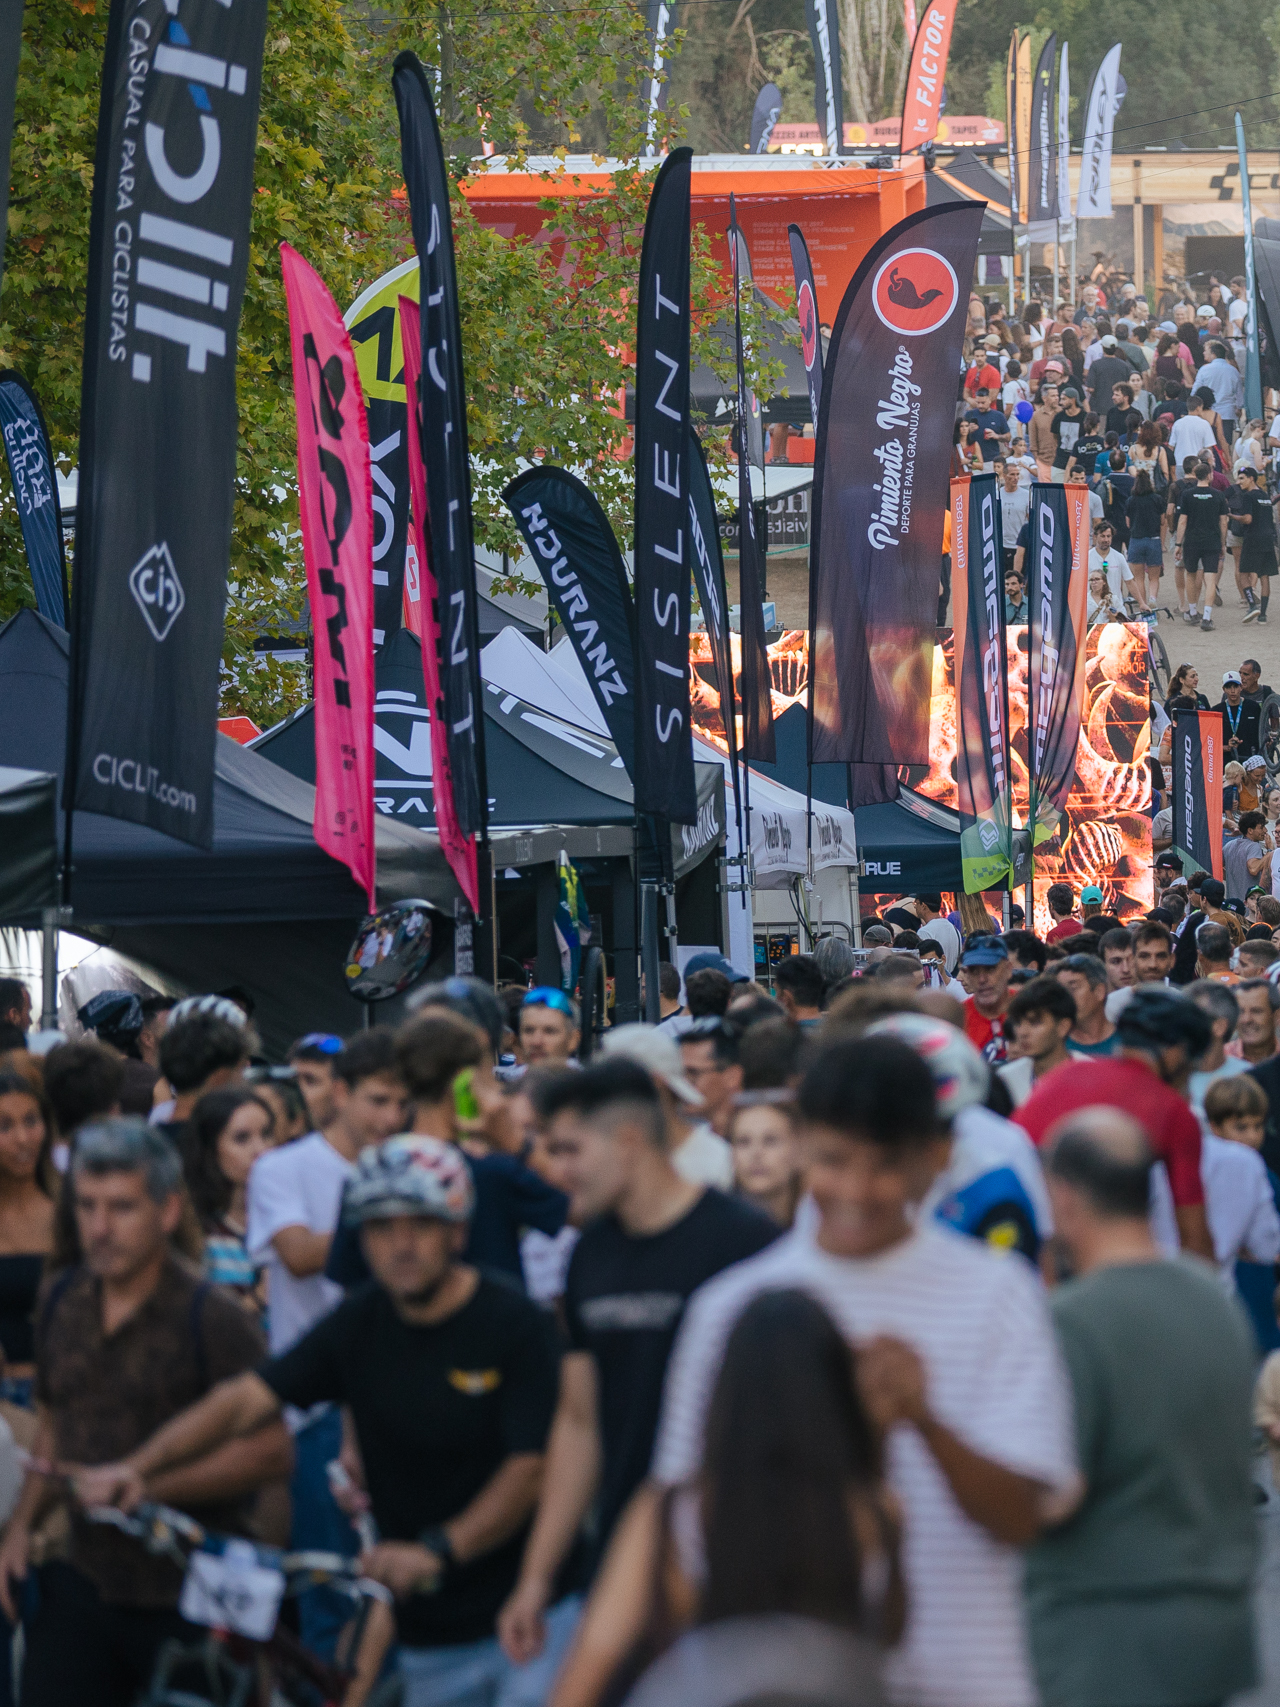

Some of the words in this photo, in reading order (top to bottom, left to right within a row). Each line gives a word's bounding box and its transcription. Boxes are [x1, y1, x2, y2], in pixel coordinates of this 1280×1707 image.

[124, 17, 152, 141] CASUAL
[915, 9, 946, 108] FACTOR
[117, 139, 138, 213] PARA
[109, 222, 133, 363] CICLISTAS
[906, 402, 921, 458] GRANUJAS
[654, 273, 684, 743] SISLENT
[867, 437, 904, 550] Pimiento
[904, 460, 916, 487] PARA
[900, 488, 912, 534] DEPORTE
[1206, 735, 1215, 754] 1987
[1206, 755, 1215, 783] Girona
[1184, 734, 1194, 850] megamo
[865, 861, 901, 876] RUE
